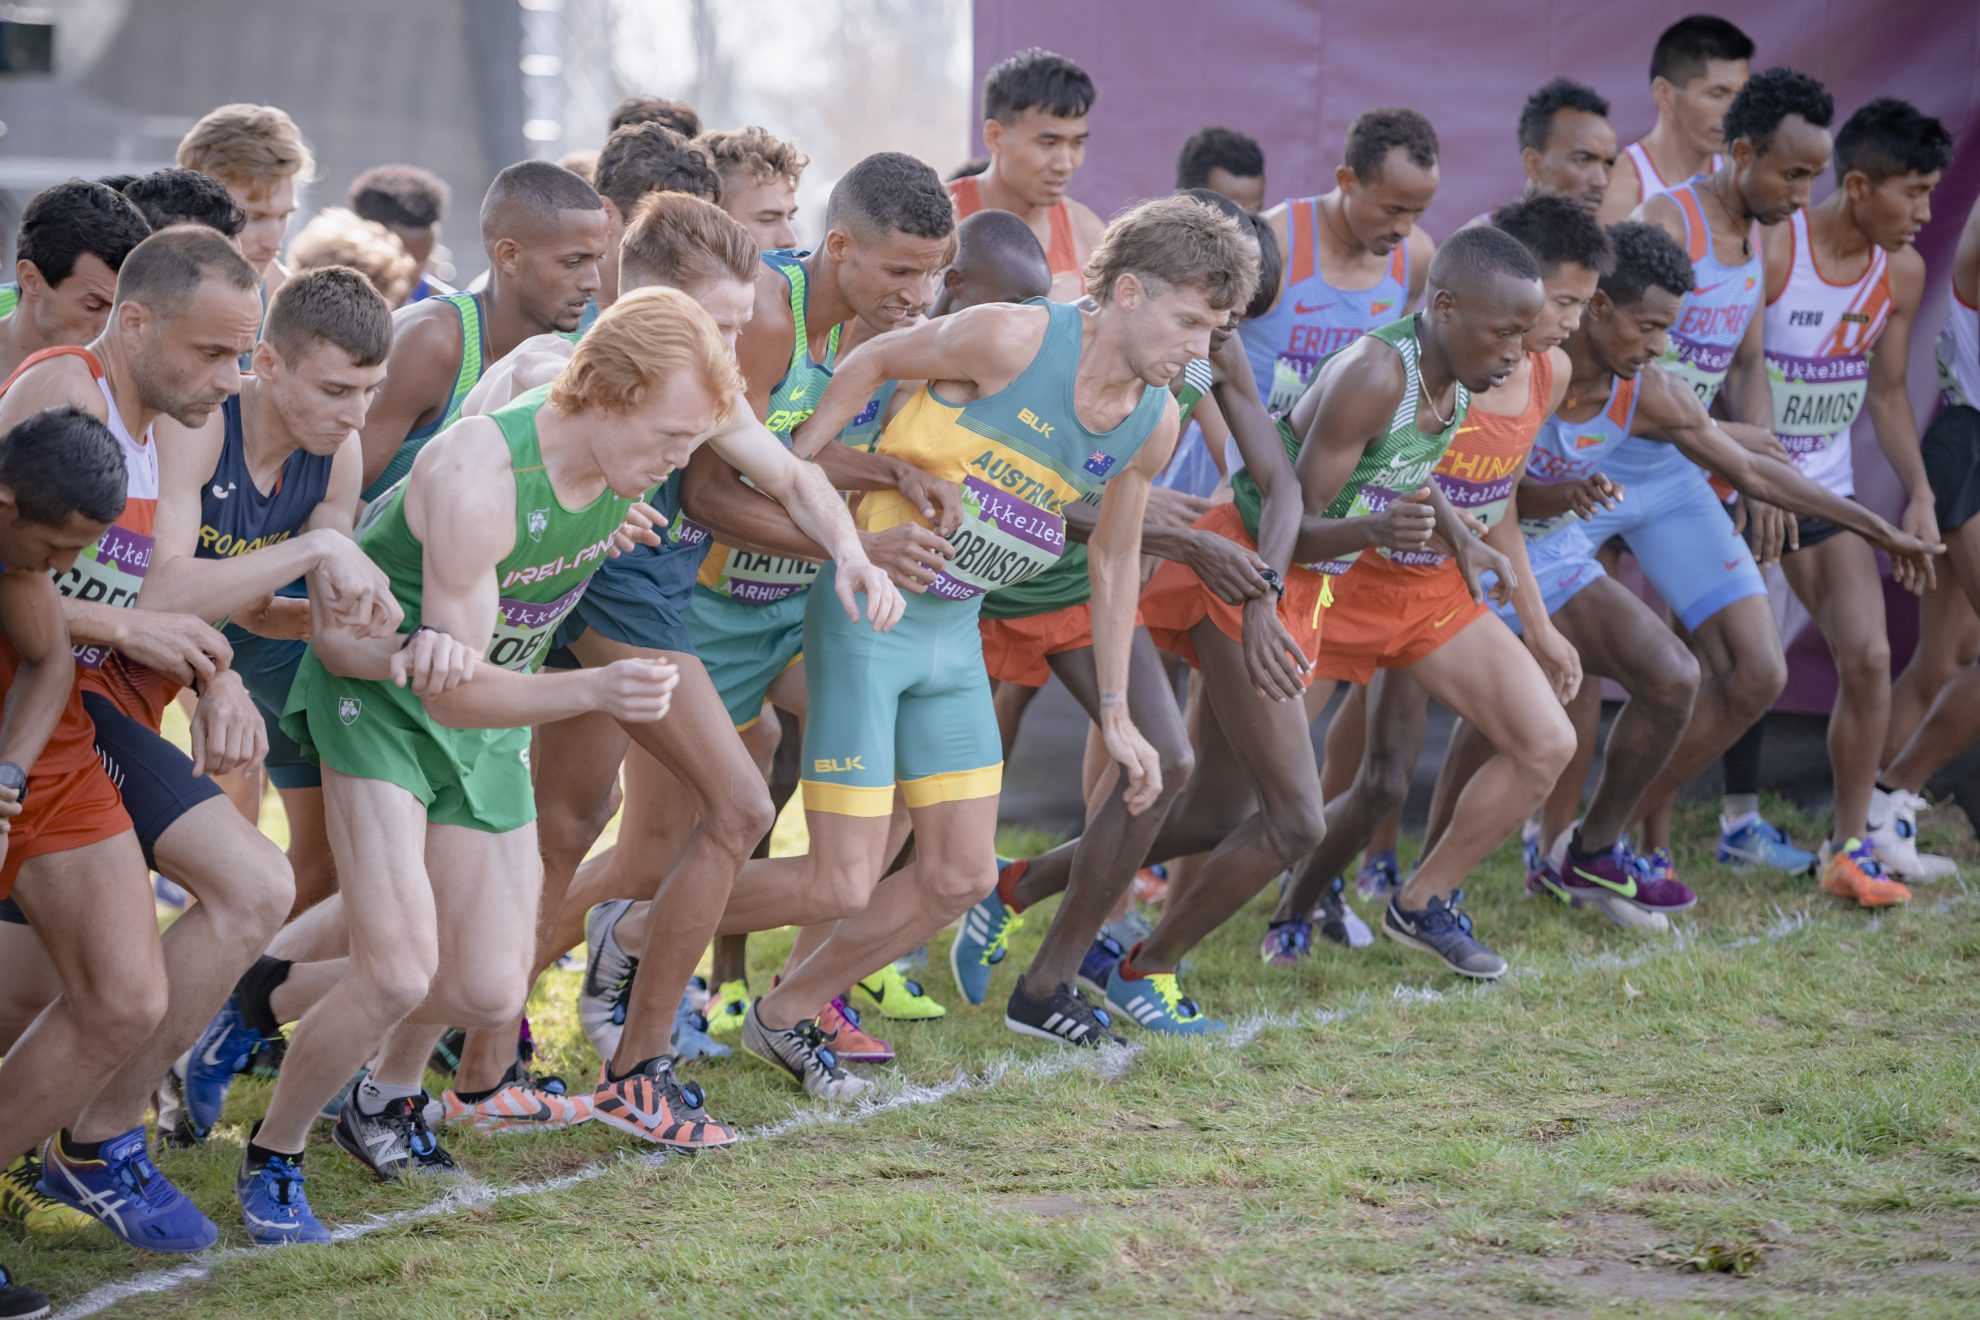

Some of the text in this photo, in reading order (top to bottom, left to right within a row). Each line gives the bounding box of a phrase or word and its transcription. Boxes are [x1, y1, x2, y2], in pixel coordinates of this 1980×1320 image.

[1789, 310, 1824, 326] PERU
[1016, 406, 1056, 440] BLK
[1783, 392, 1858, 426] RAMOS
[962, 485, 1064, 546] Mikkeller
[937, 529, 1046, 586] OBINSON
[814, 755, 868, 773] BLK
